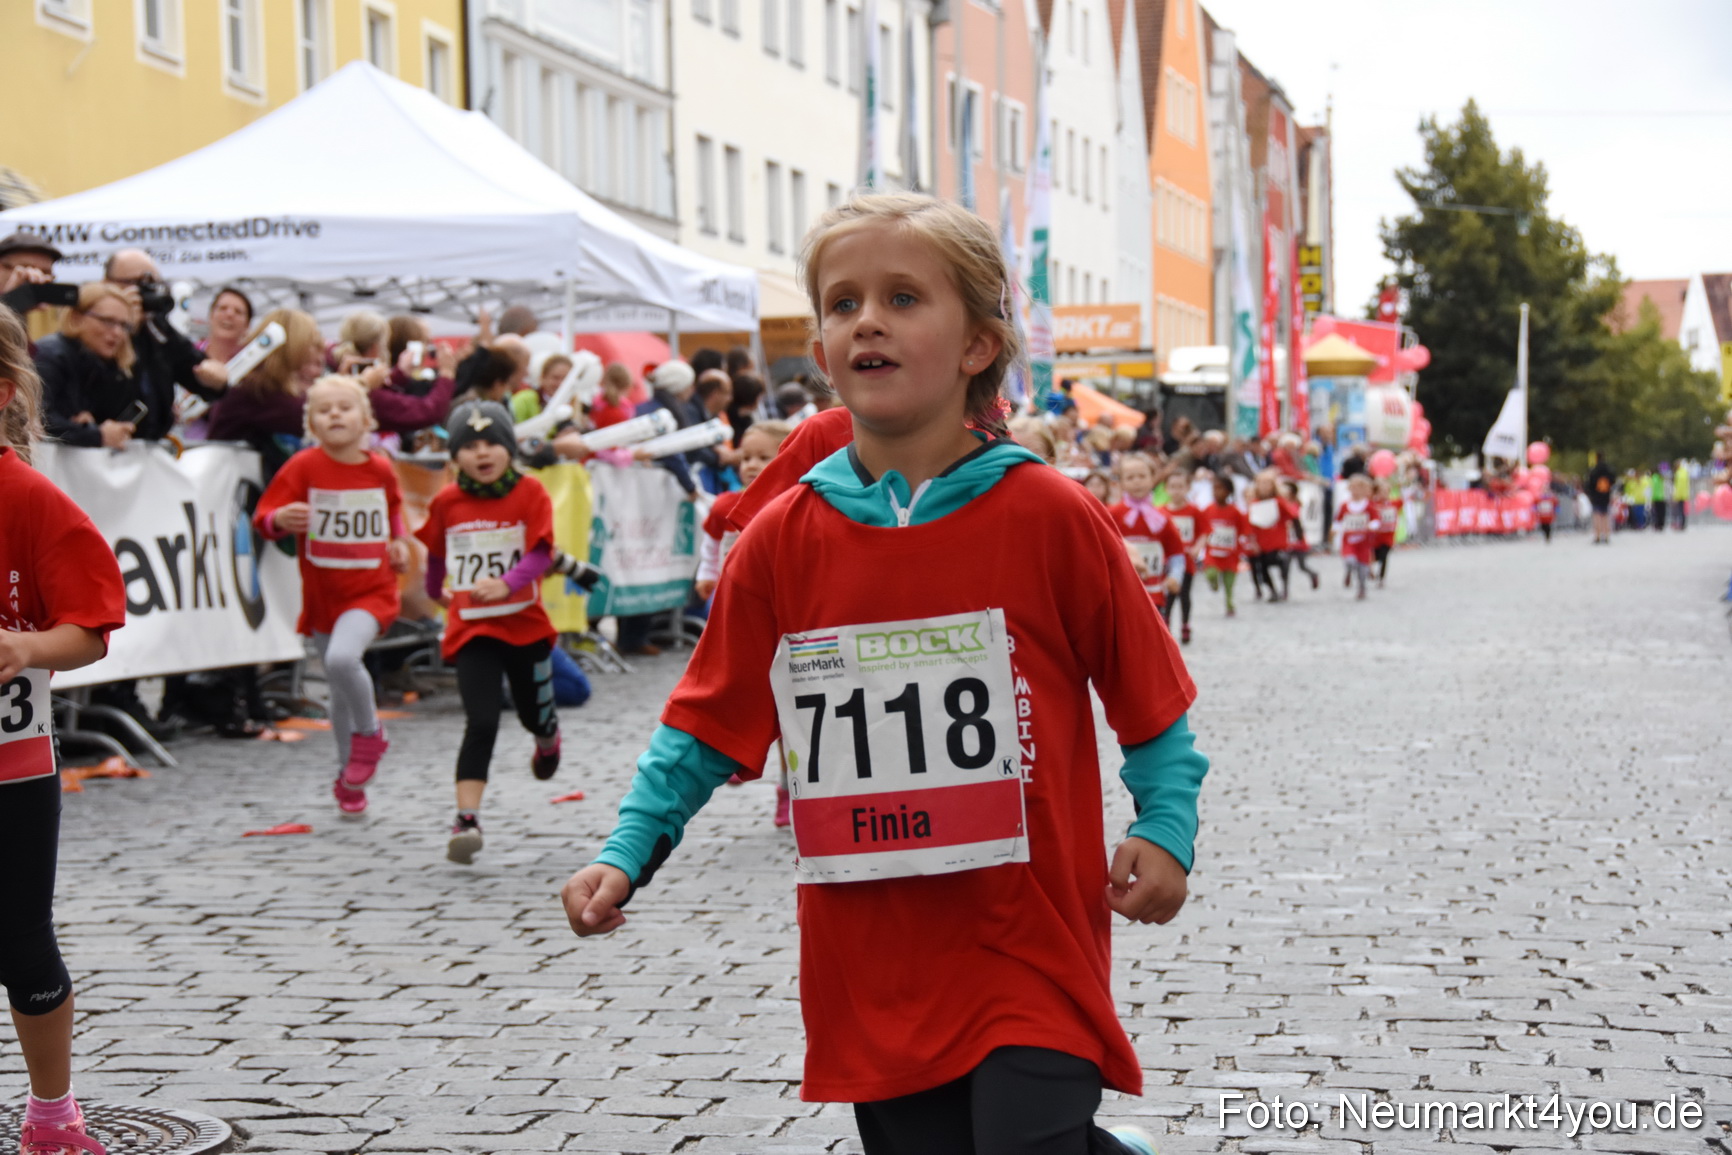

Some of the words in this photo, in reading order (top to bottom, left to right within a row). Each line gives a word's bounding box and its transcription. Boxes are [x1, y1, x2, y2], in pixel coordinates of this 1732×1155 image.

[101, 217, 321, 242] ConnectedDrive
[316, 509, 382, 538] 7500
[856, 622, 986, 662] BOCK
[789, 657, 845, 674] NeuerMarkt
[858, 661, 896, 673] inspired
[899, 659, 911, 670] by
[914, 658, 942, 667] smart
[945, 653, 988, 665] concepts
[0, 676, 33, 733] 3
[1007, 634, 1035, 783] BMBINI
[37, 724, 45, 733] K
[795, 677, 996, 783] 7118
[1003, 759, 1013, 775] K
[852, 804, 931, 843] Finia
